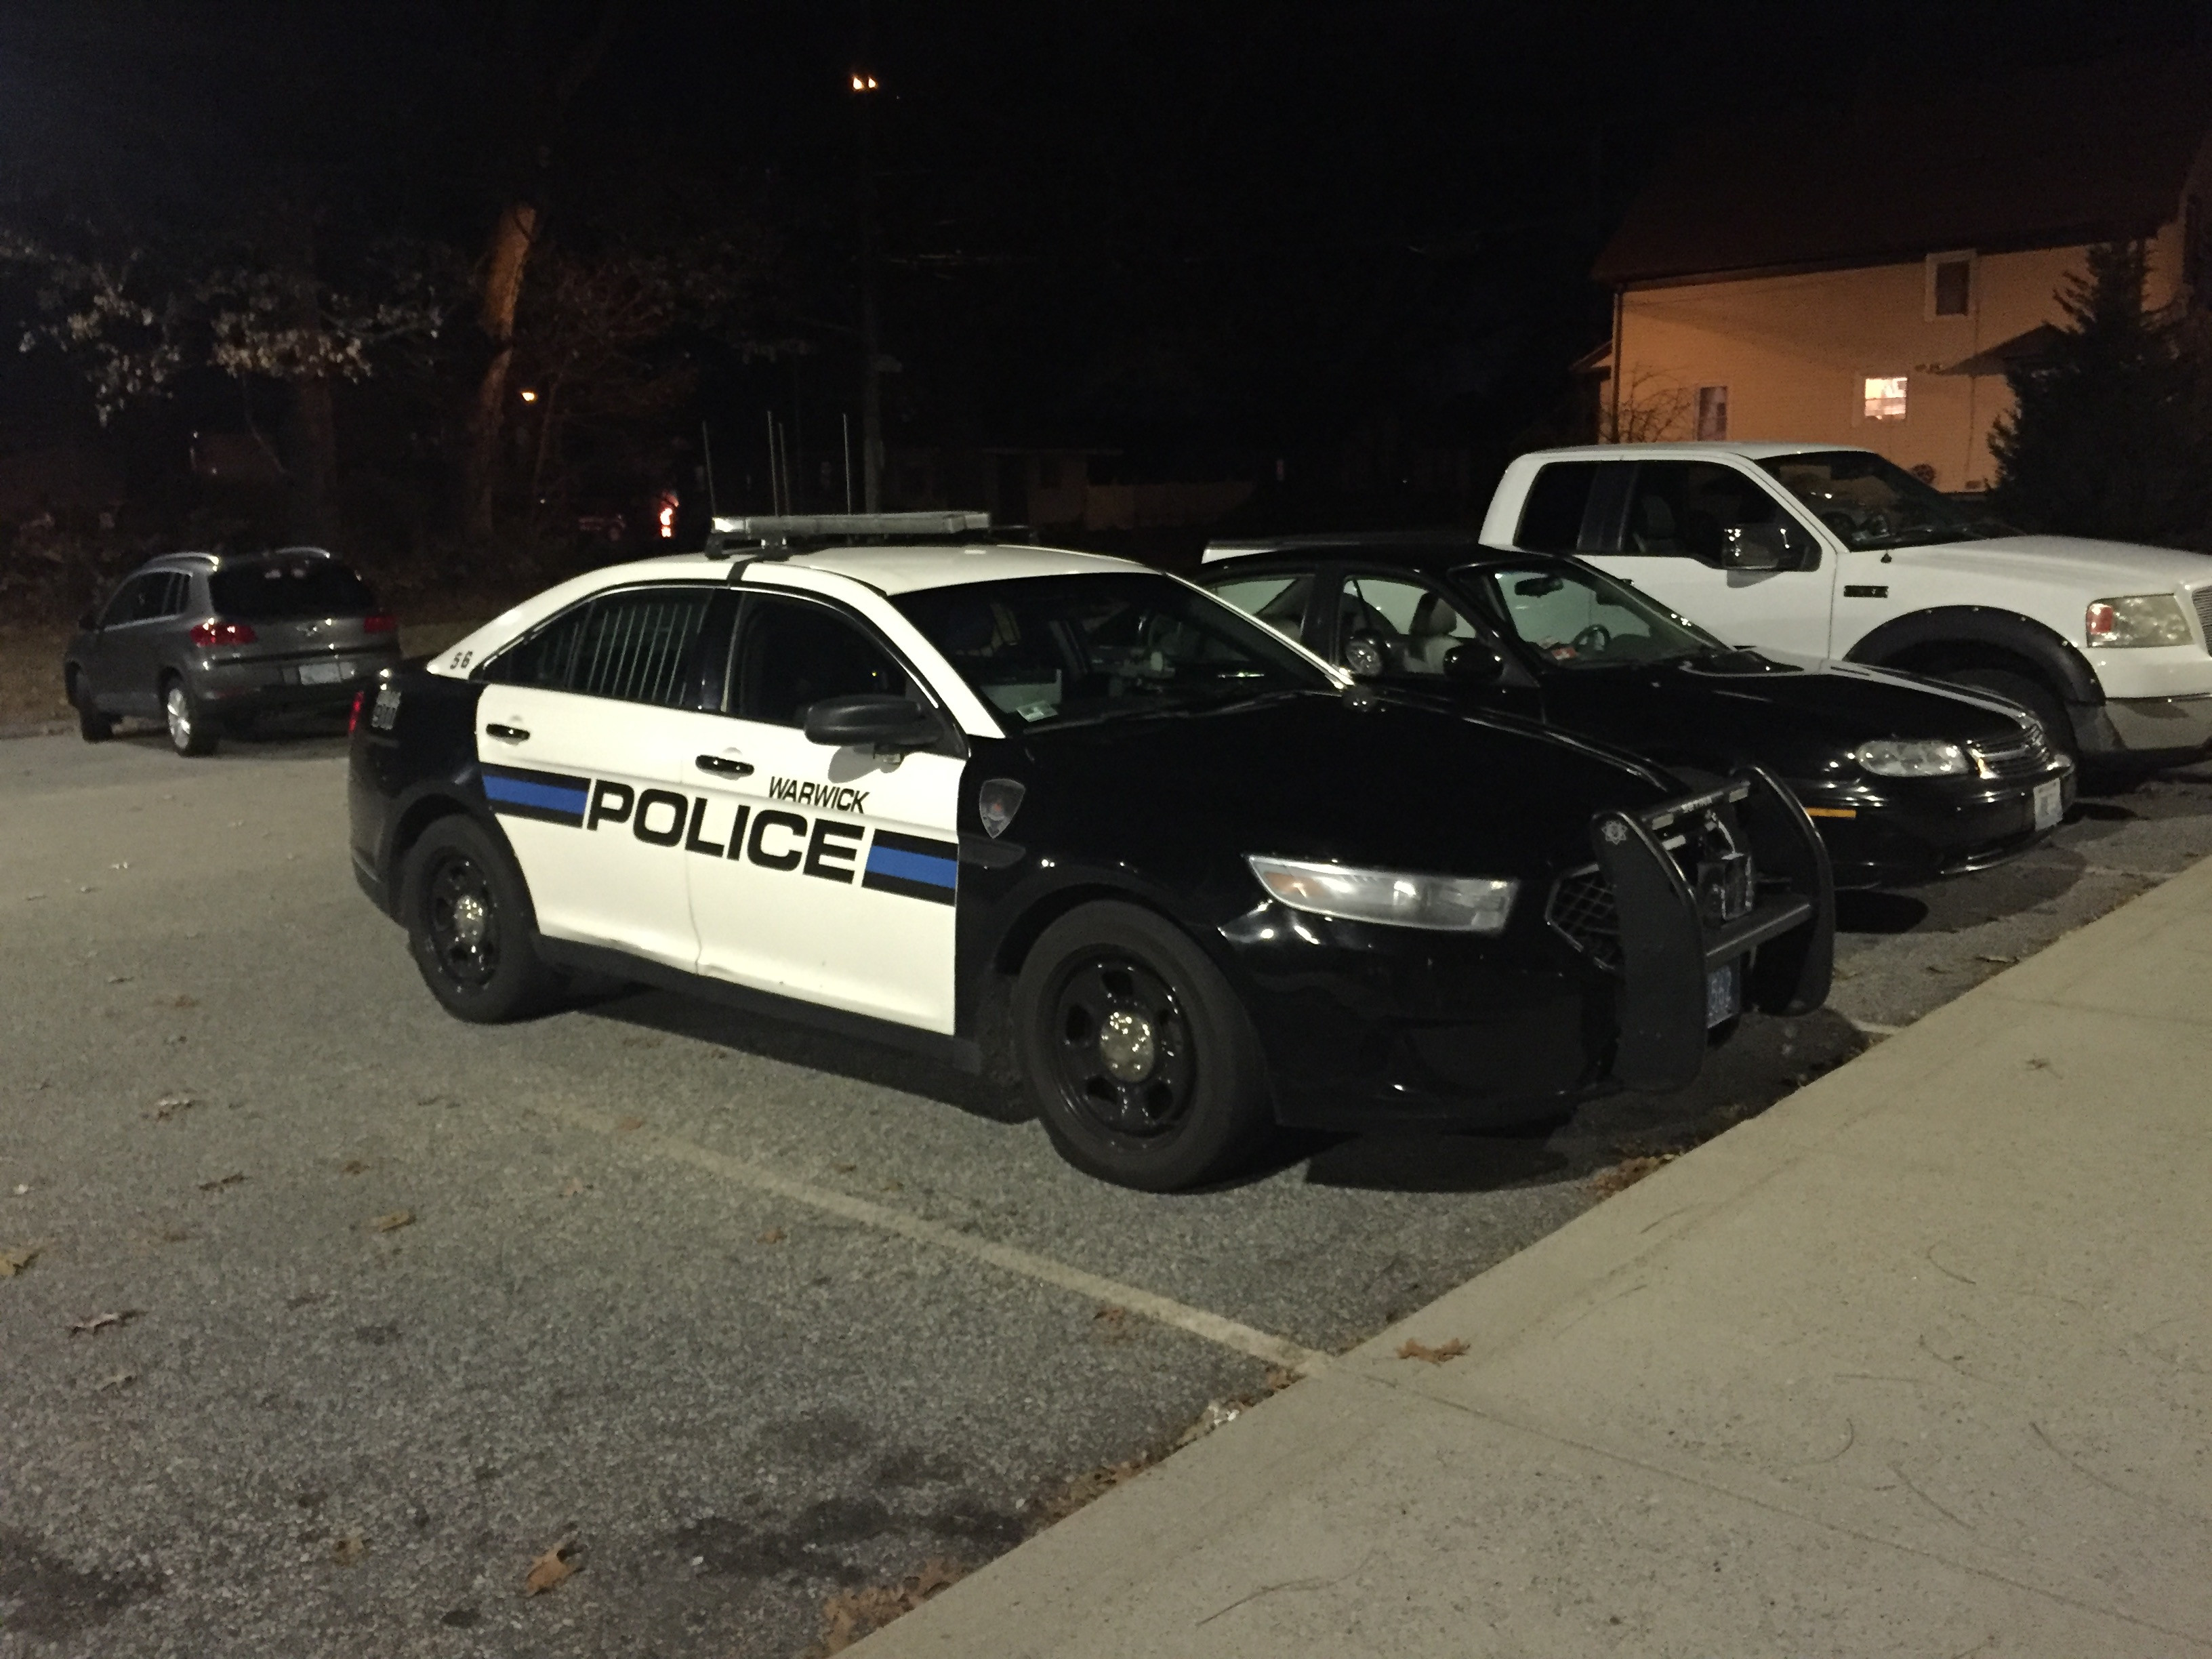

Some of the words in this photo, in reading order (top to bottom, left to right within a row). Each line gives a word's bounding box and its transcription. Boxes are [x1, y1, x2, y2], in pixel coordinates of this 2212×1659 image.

[450, 651, 473, 670] 56
[769, 776, 870, 813] WARWICK
[587, 779, 865, 884] POLICE
